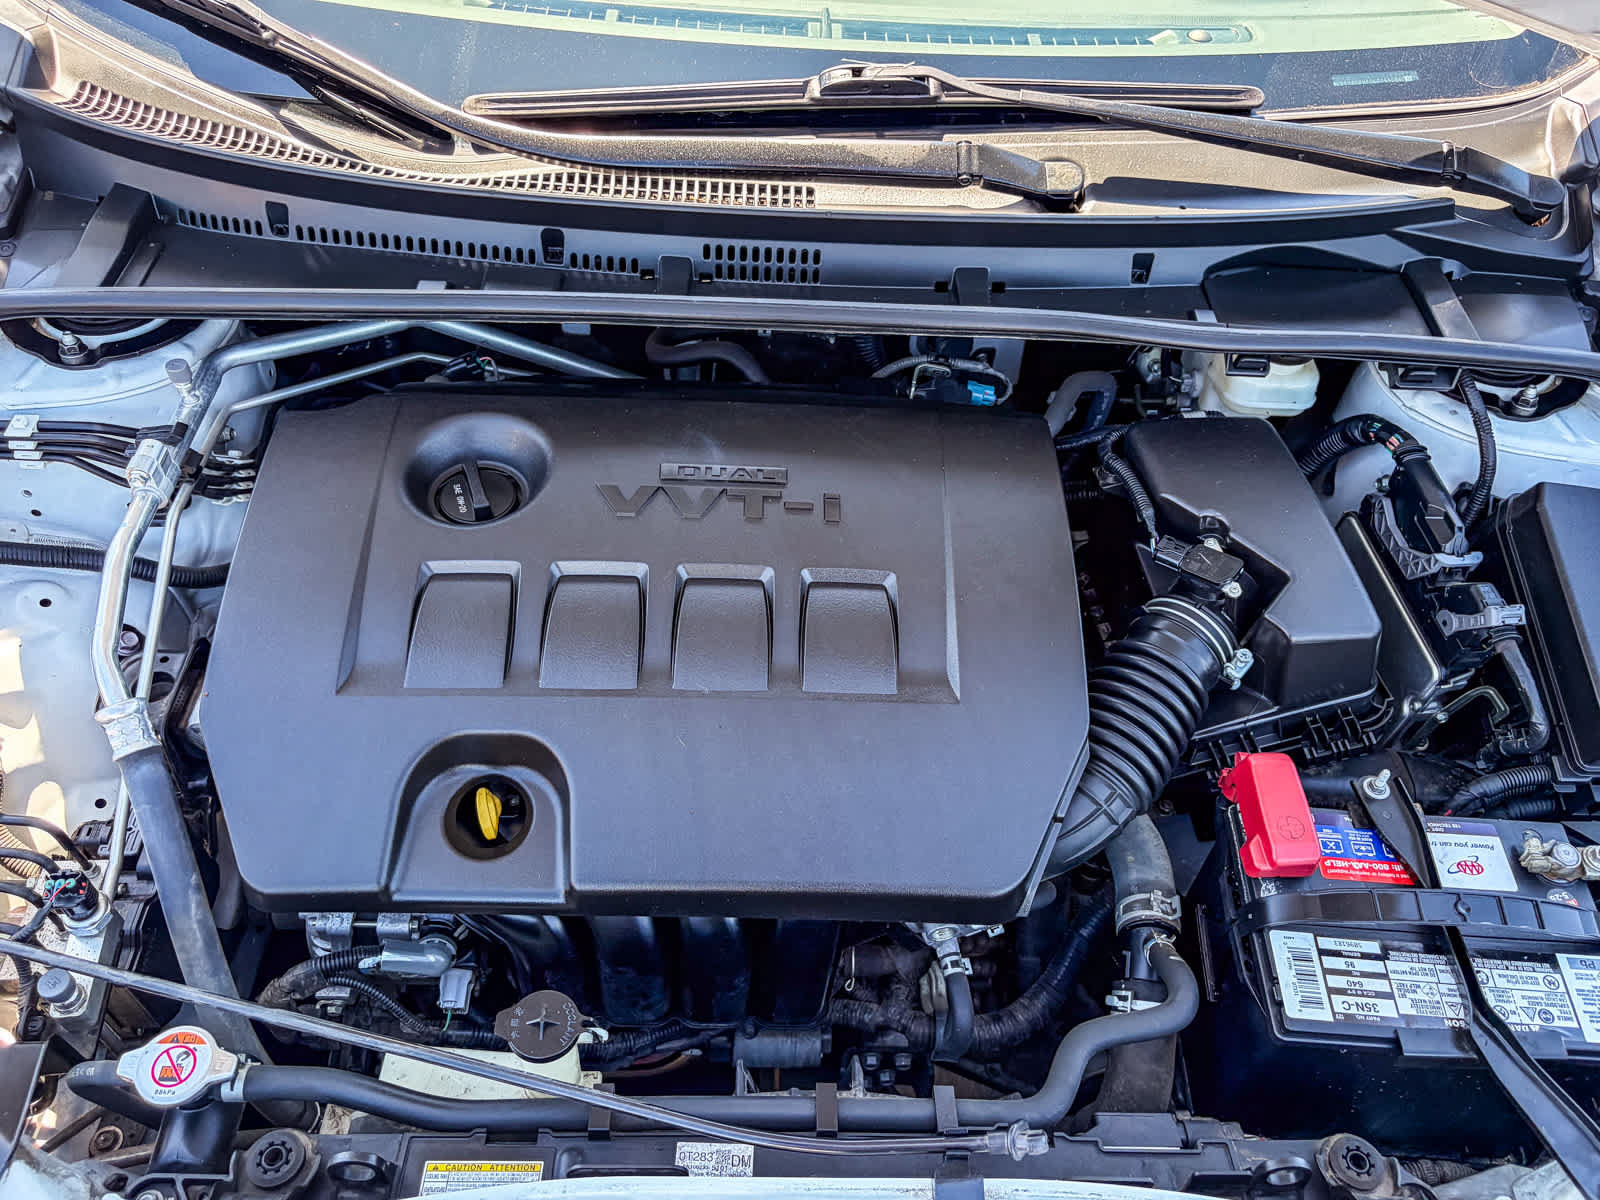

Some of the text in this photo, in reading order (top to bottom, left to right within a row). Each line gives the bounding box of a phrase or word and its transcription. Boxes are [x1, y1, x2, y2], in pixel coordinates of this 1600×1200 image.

[670, 464, 781, 481] DUAL
[596, 484, 842, 524] VVT-i
[1471, 843, 1494, 851] Power
[1457, 861, 1483, 875] AAA
[1579, 959, 1596, 969] Pb
[1346, 979, 1364, 987] 640
[1341, 1000, 1379, 1014] 35N-C
[490, 1163, 536, 1171] ATTENTION
[731, 1154, 751, 1168] DM
